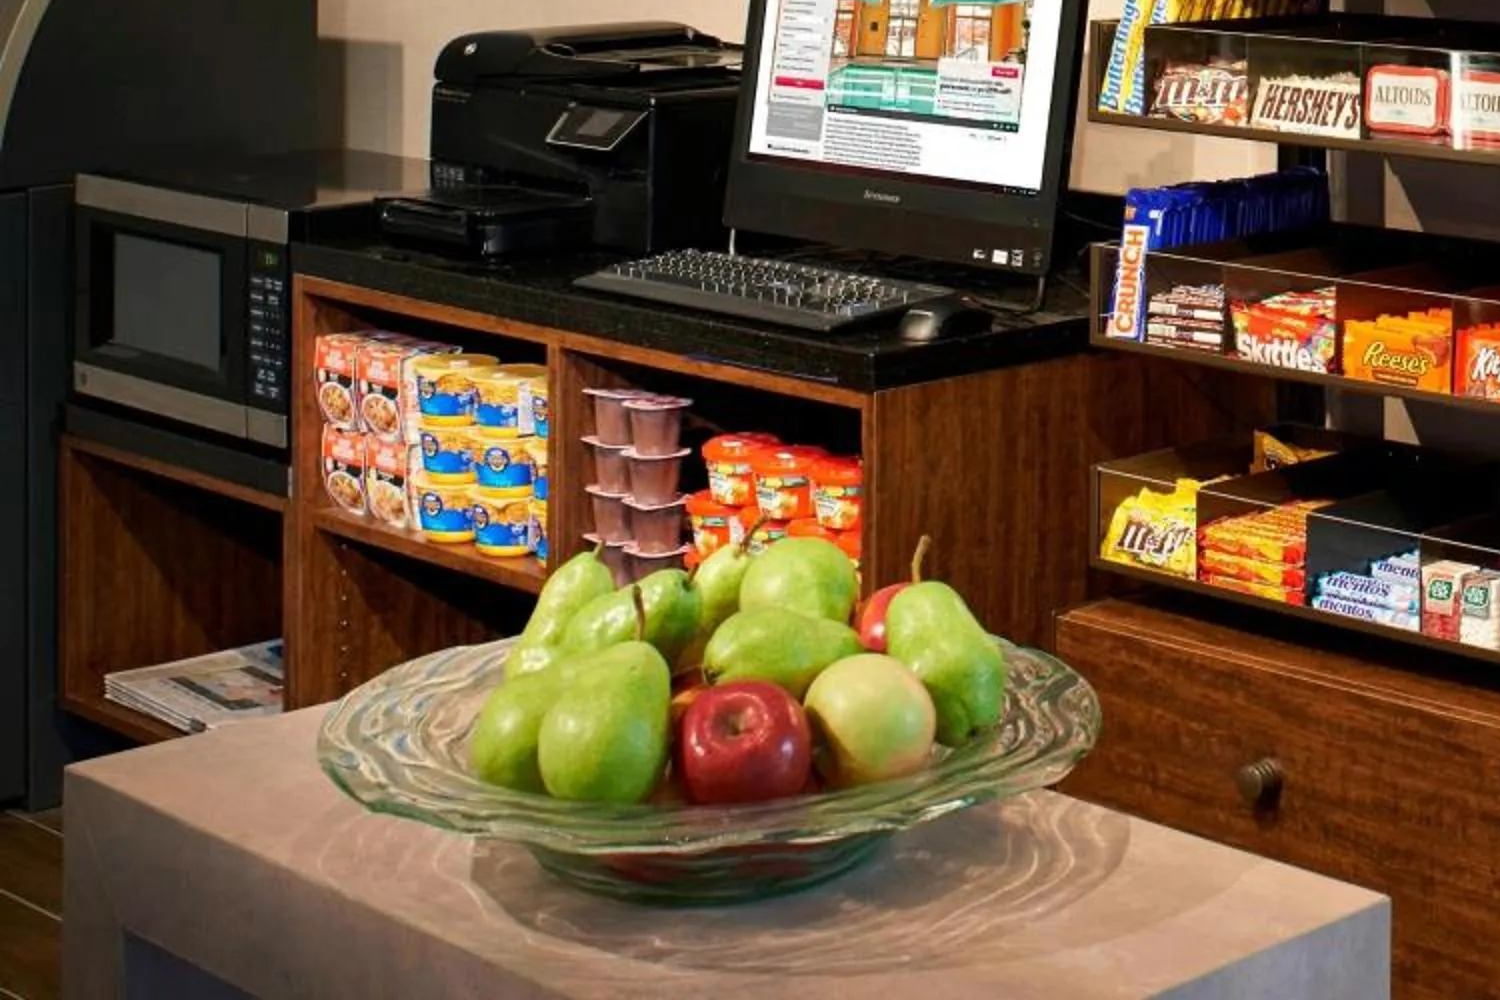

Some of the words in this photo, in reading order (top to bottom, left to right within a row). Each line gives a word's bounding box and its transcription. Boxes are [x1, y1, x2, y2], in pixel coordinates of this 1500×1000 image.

[1259, 82, 1360, 131] HERSHEY'S
[1375, 84, 1433, 107] ALTOIDS
[1115, 229, 1145, 333] CRUNCH
[1235, 333, 1328, 374] Skittles
[1363, 340, 1431, 376] Reese's
[1377, 560, 1420, 579] mento
[1318, 598, 1375, 619] mentos
